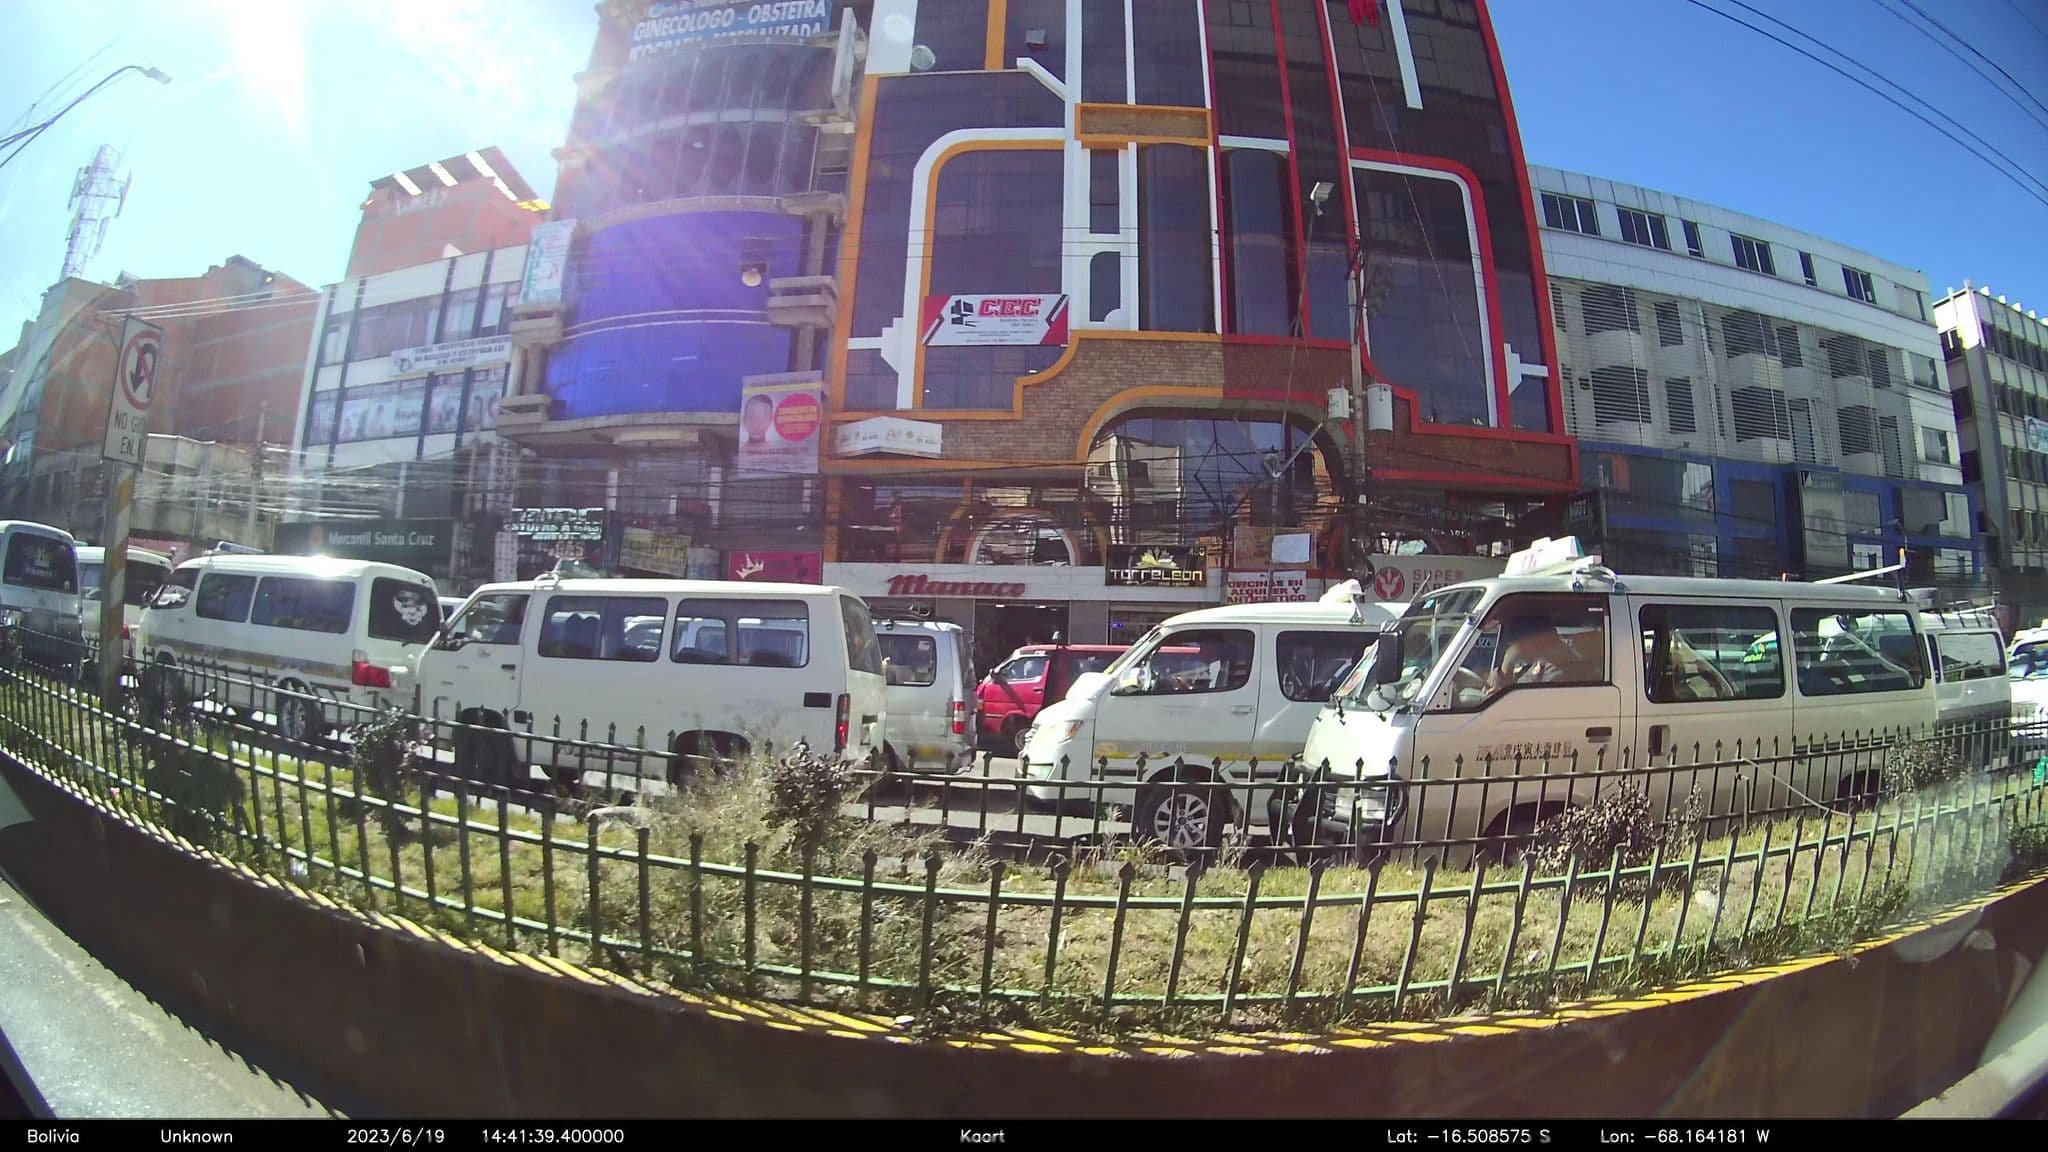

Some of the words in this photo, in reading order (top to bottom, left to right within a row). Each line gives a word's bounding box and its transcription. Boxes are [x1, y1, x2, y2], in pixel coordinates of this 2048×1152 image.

[634, 8, 737, 41] GINECOLOGO
[748, 0, 826, 25] OBSTETRA
[115, 410, 127, 429] NO
[374, 531, 405, 545] Santa
[409, 531, 435, 546] Cruz
[887, 575, 1026, 597] Manaco
[1231, 587, 1288, 596] ALQUIER
[1292, 586, 1300, 594] Y
[1288, 579, 1303, 587] EN
